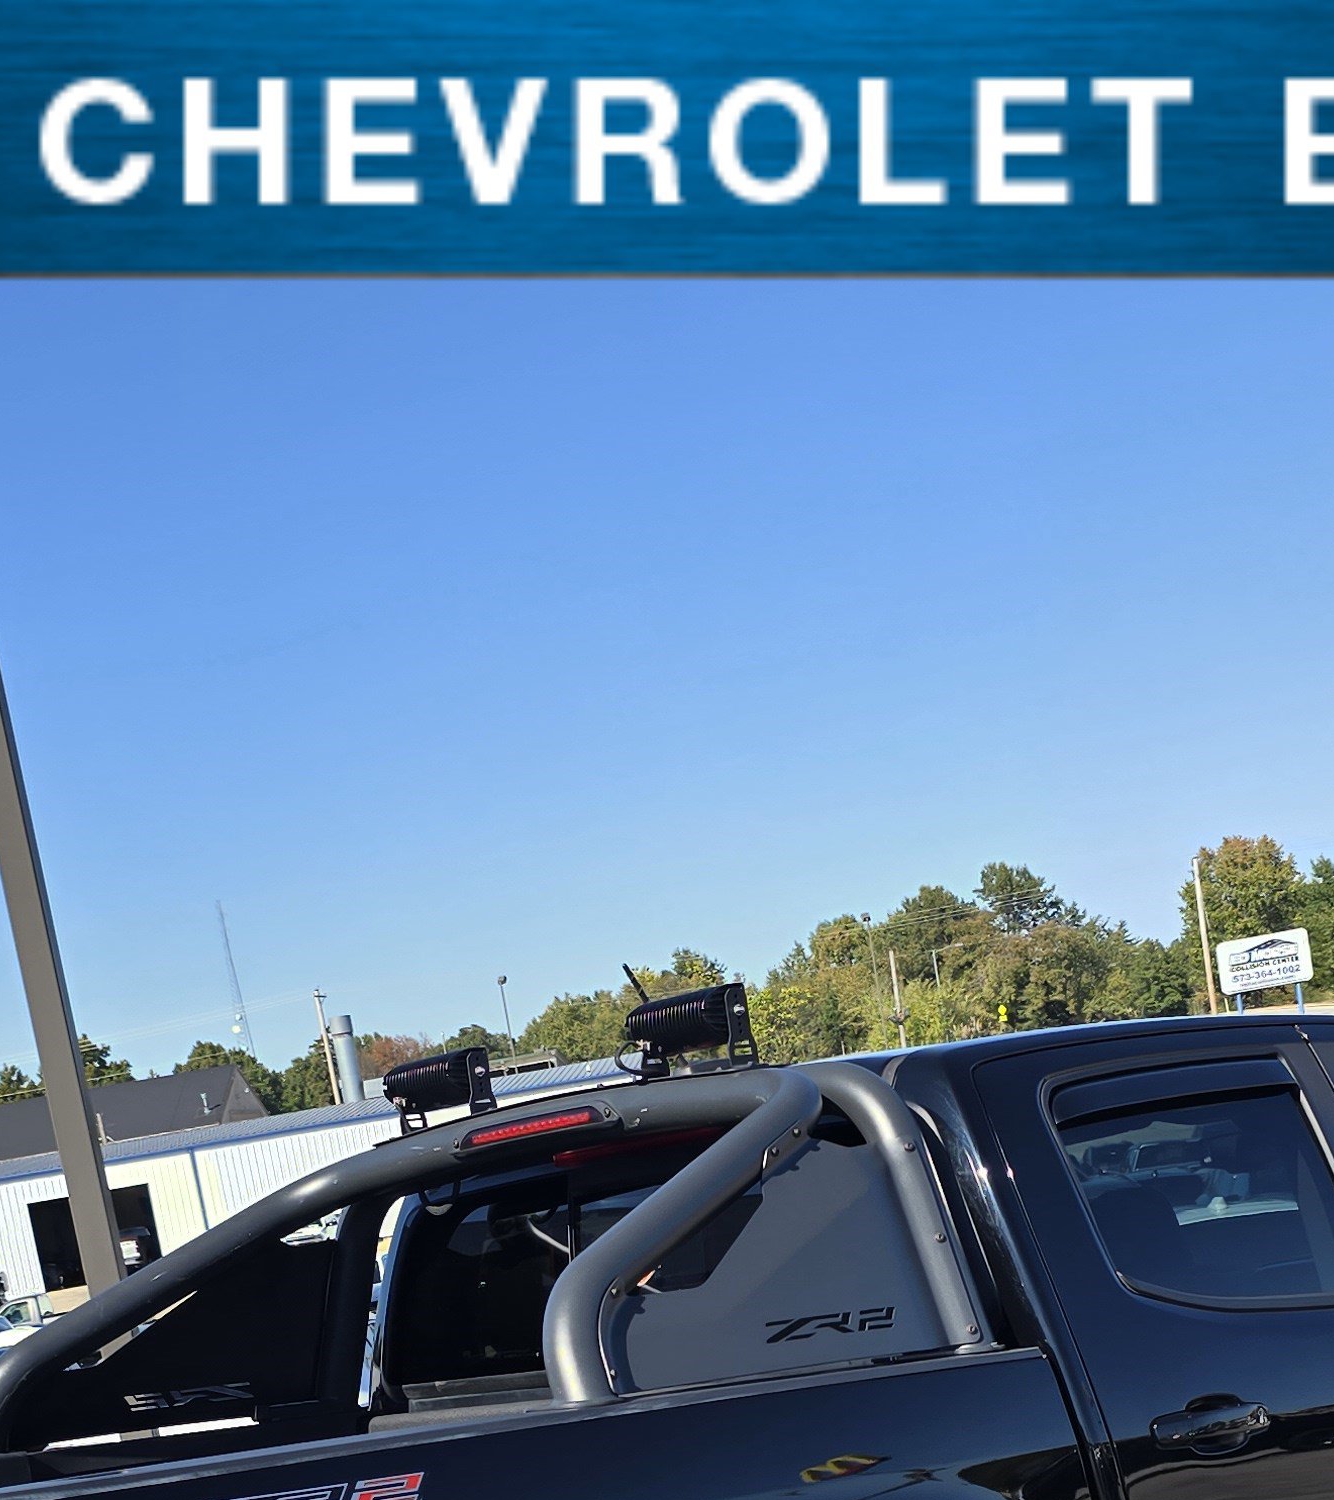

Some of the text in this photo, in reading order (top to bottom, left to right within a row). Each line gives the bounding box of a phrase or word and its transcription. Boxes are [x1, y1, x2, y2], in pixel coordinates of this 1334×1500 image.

[1272, 956, 1299, 966] CENTER
[1232, 964, 1301, 983] 573-364-1002
[765, 1306, 897, 1344] ZR2
